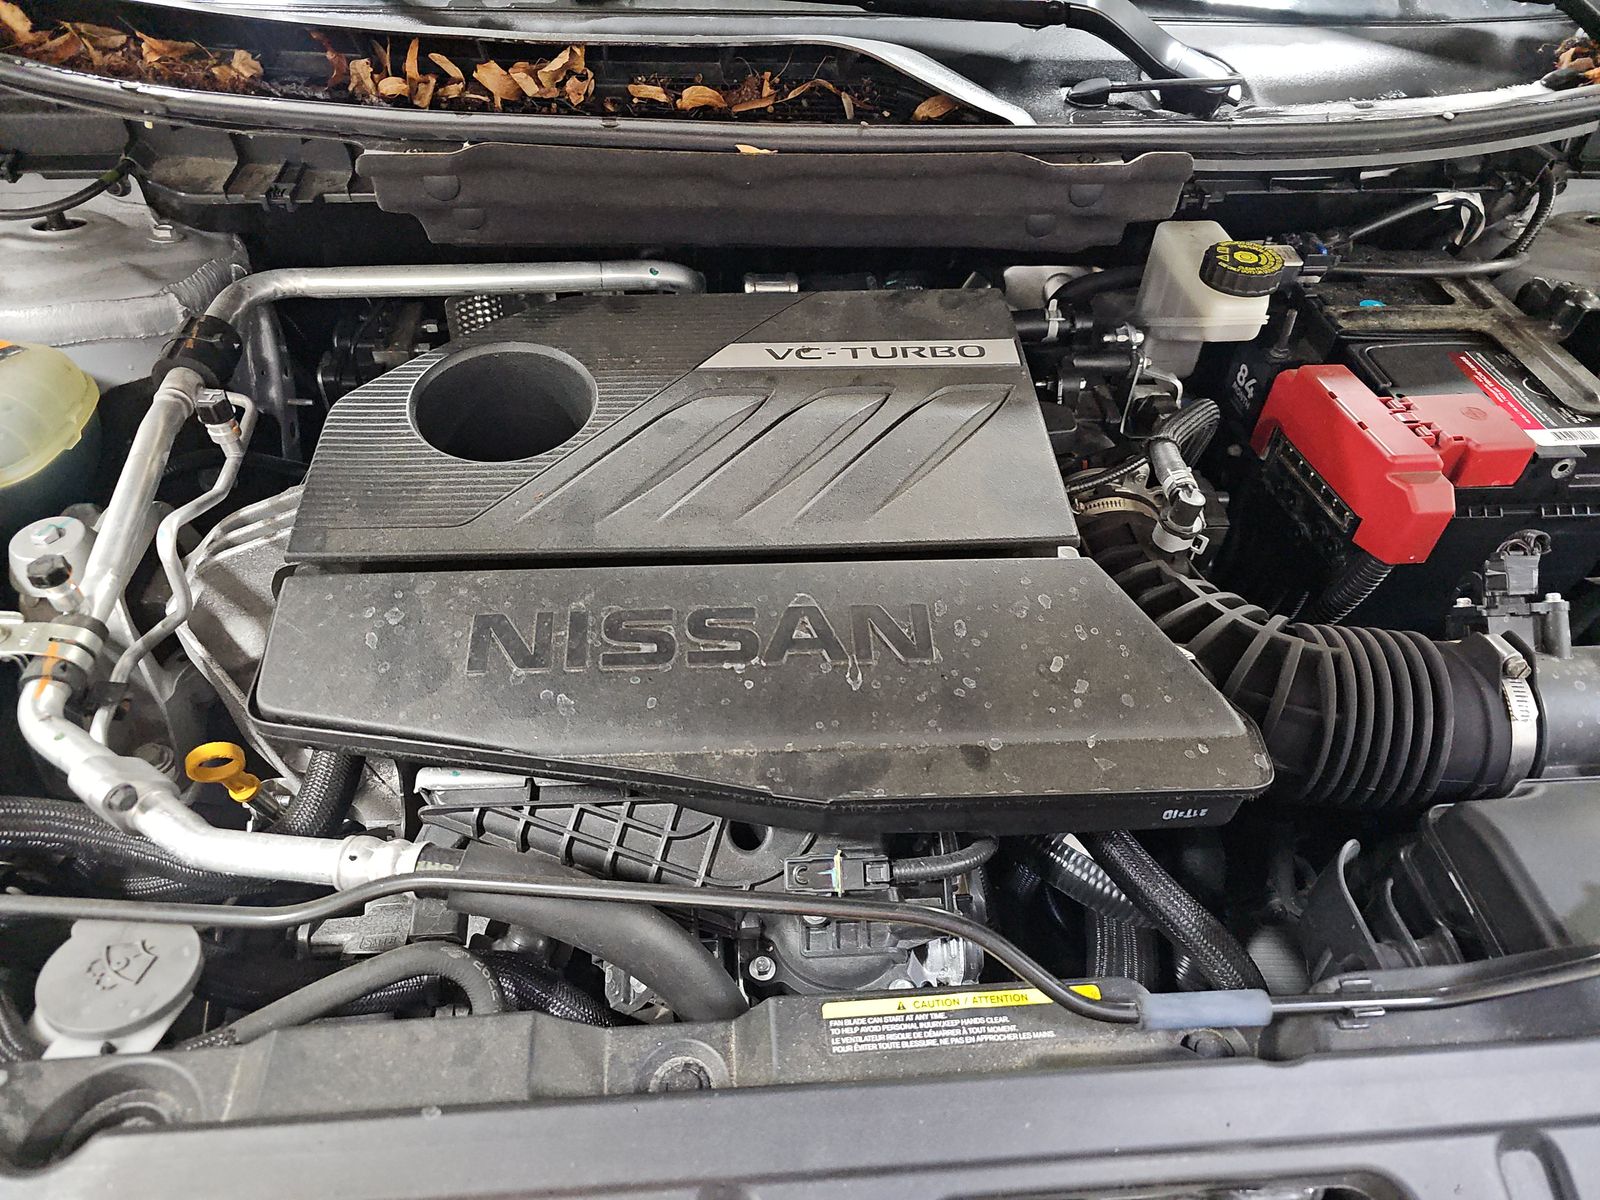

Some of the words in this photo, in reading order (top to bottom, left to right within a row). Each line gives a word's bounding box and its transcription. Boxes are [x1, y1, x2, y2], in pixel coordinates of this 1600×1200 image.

[765, 345, 986, 361] VC-TURBO
[1237, 363, 1257, 399] 84
[466, 603, 933, 676] NISSAN
[913, 998, 960, 1009] CAUTION
[972, 993, 1029, 1004] ATTENTION
[844, 1018, 867, 1026] BLADE
[867, 1016, 884, 1024] CAN
[884, 1015, 905, 1024] START
[905, 1014, 914, 1022] AT
[914, 1013, 929, 1021] ANY
[860, 1025, 882, 1033] AVOID
[882, 1023, 919, 1032] PERSONAL
[960, 1017, 985, 1025] HANDS
[832, 1037, 840, 1045] LE
[840, 1034, 885, 1044] VENTILATEUR
[886, 1032, 913, 1040] RISQUE
[913, 1031, 924, 1039] DE
[924, 1029, 961, 1037] DÉMARRER
[962, 1025, 968, 1035] À
[968, 1026, 986, 1034] TOUT
[833, 1045, 853, 1053] POUR
[854, 1042, 877, 1052] ÉVITER
[878, 1041, 902, 1049] TOUTE
[950, 1037, 964, 1045] PAS
[976, 1033, 1019, 1042] APPROCHER
